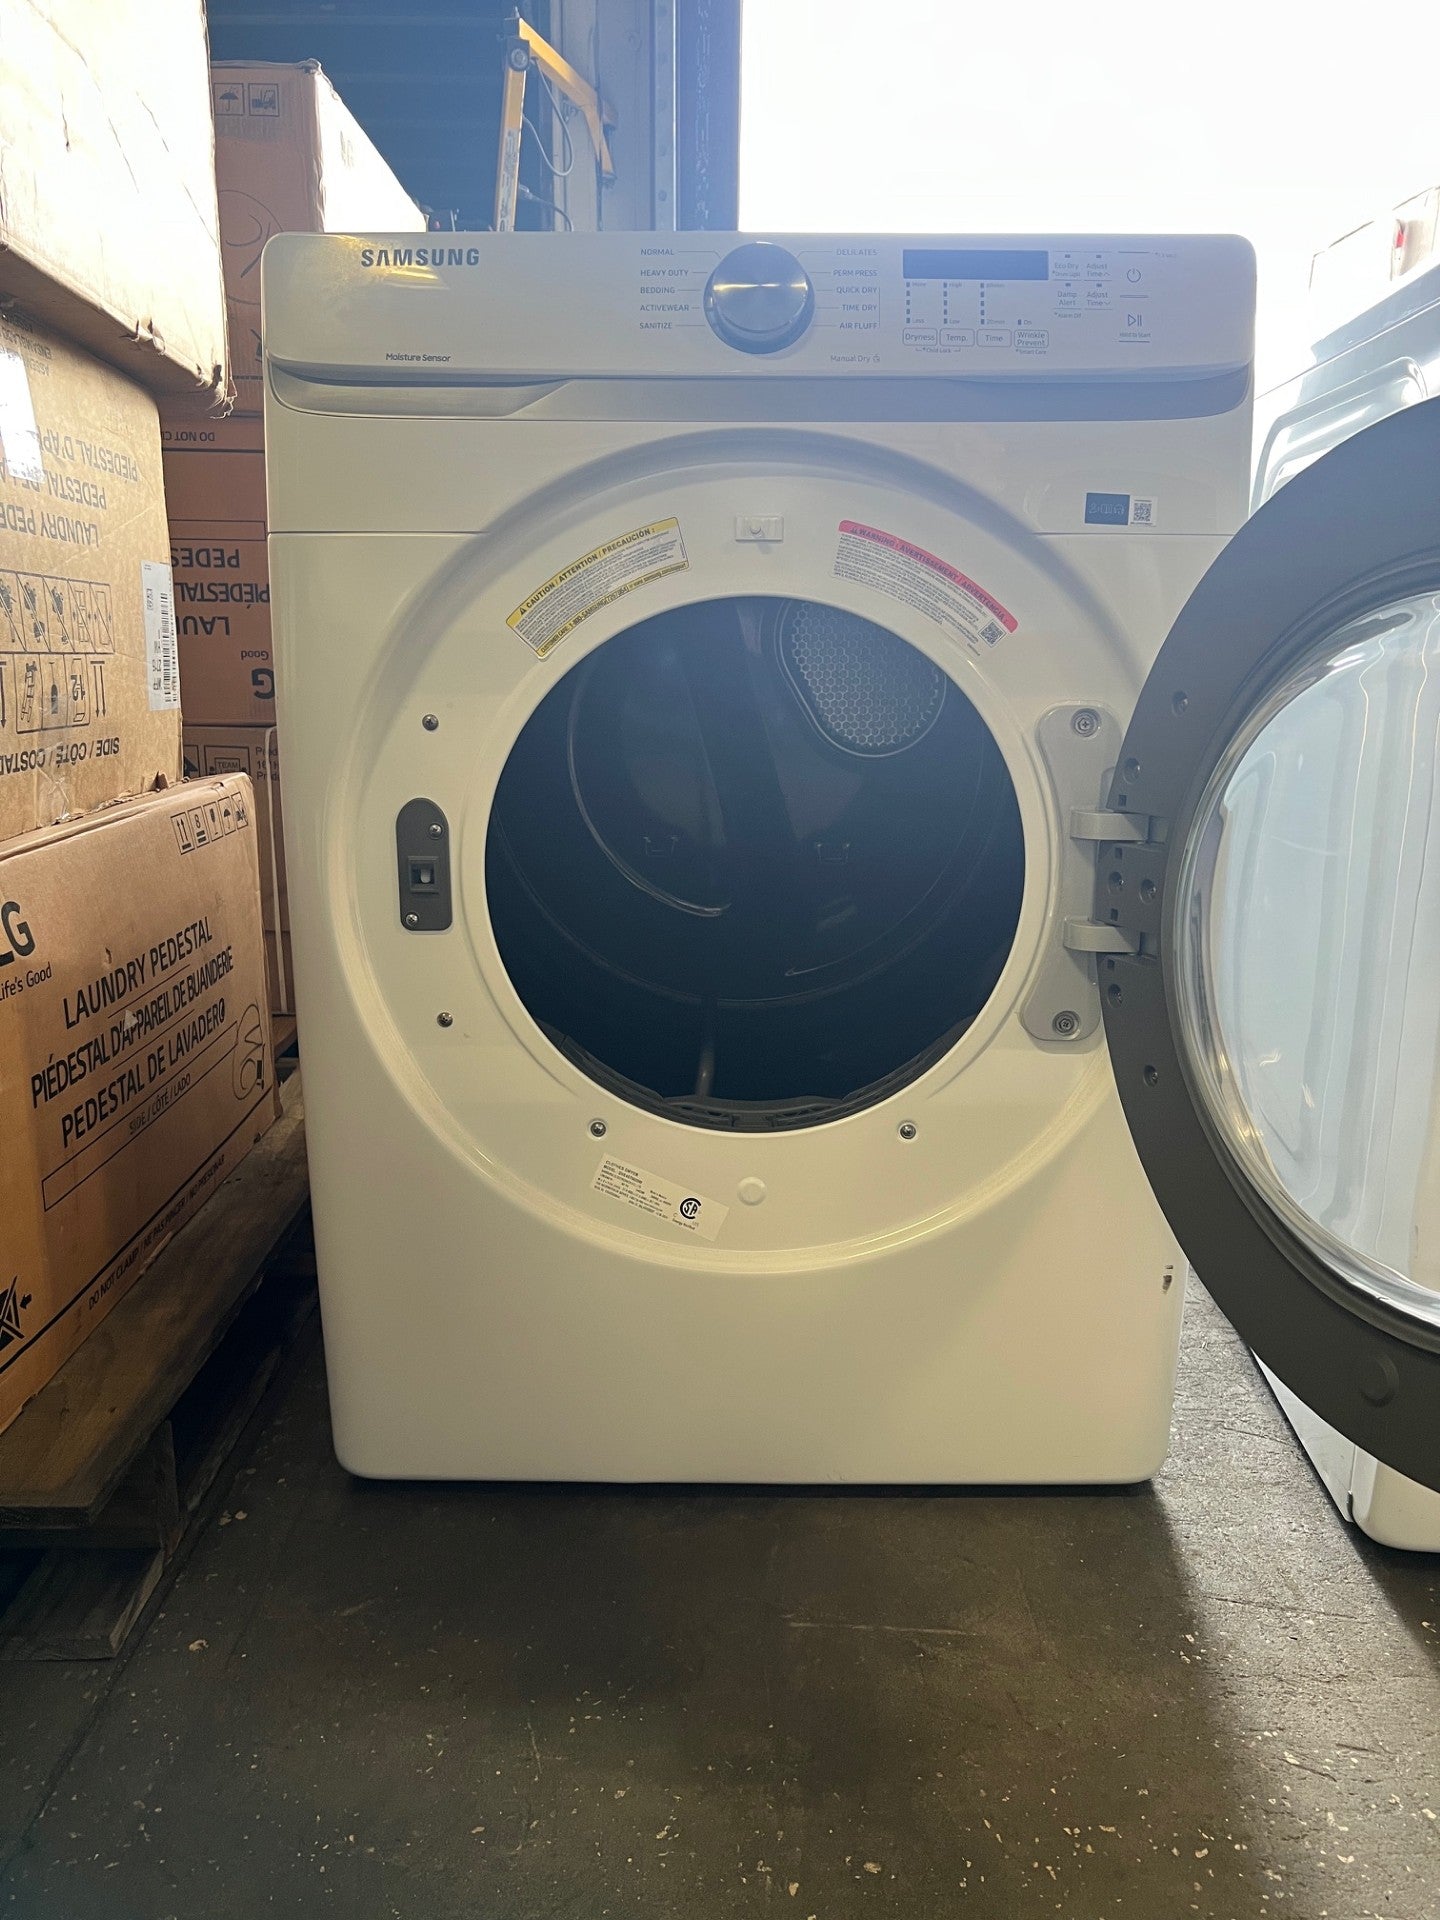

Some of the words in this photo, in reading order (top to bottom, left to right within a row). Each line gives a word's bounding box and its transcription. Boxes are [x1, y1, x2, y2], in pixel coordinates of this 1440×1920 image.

[640, 248, 675, 256] NORMAL
[836, 248, 878, 256] DELICATES
[360, 248, 480, 268] SAMSUNG
[1067, 262, 1079, 270] Dry
[640, 269, 667, 277] HEAVY
[668, 269, 689, 277] DUTY
[833, 269, 854, 277] PERM
[855, 269, 878, 277] PRESS
[640, 286, 676, 294] BEDDING
[836, 286, 860, 294] QUICK
[861, 286, 877, 294] DRY
[1057, 291, 1078, 299] Damp
[1086, 291, 1108, 299] Adjust
[640, 304, 690, 312] ACTIVEWEAR
[842, 304, 860, 312] TIME
[861, 304, 877, 312] DRY
[1087, 299, 1104, 307] Time
[639, 322, 673, 330] SANITIZE
[839, 322, 854, 330] AIR
[854, 322, 878, 330] FLUFF
[905, 332, 936, 342] Dryness
[946, 333, 969, 342] Temp.
[985, 334, 1004, 342] Time
[1017, 331, 1046, 339] Wrinkle
[1017, 338, 1046, 346] Prevent
[385, 353, 421, 362] Moisture
[421, 354, 452, 363] Sensor
[830, 353, 857, 362] Manual
[857, 354, 871, 363] Dry
[175, 431, 197, 441] NOT
[199, 431, 216, 441] DO
[75, 438, 138, 484] PIÉDESTAL
[43, 469, 107, 510] PEDESTAL
[40, 511, 100, 549] LAUNDRY
[526, 582, 556, 609] CAUTION
[558, 553, 599, 583] ATTENTION
[602, 527, 652, 555] PRECAUCIÓN
[858, 527, 896, 548] WARNING
[960, 580, 1007, 623] ADVERTENCIA
[173, 582, 271, 609] PIÉDESTAL
[175, 615, 231, 636] LAU
[240, 650, 270, 661] Good
[95, 736, 120, 758] SIDE
[55, 741, 88, 769] CÔTÉ
[217, 760, 239, 770] TEAM
[62, 952, 147, 1030] LAUNDRY
[149, 915, 214, 978] PEDESTAL
[0, 975, 24, 1000] ife's
[26, 961, 53, 988] Good
[30, 1035, 111, 1110] PIÉDESTAL
[172, 979, 188, 1015] DE
[187, 945, 235, 1004] BUANDERIE
[61, 1063, 146, 1149] PEDESTAL
[147, 1044, 167, 1085] DE
[168, 997, 226, 1067] LAVADERO
[128, 1111, 147, 1136] SIDE
[151, 1092, 170, 1118] CÔTÉ
[172, 1072, 192, 1100] LADO
[88, 1289, 101, 1311] DO
[100, 1271, 117, 1298] NOT
[115, 1246, 140, 1280] CLAMP
